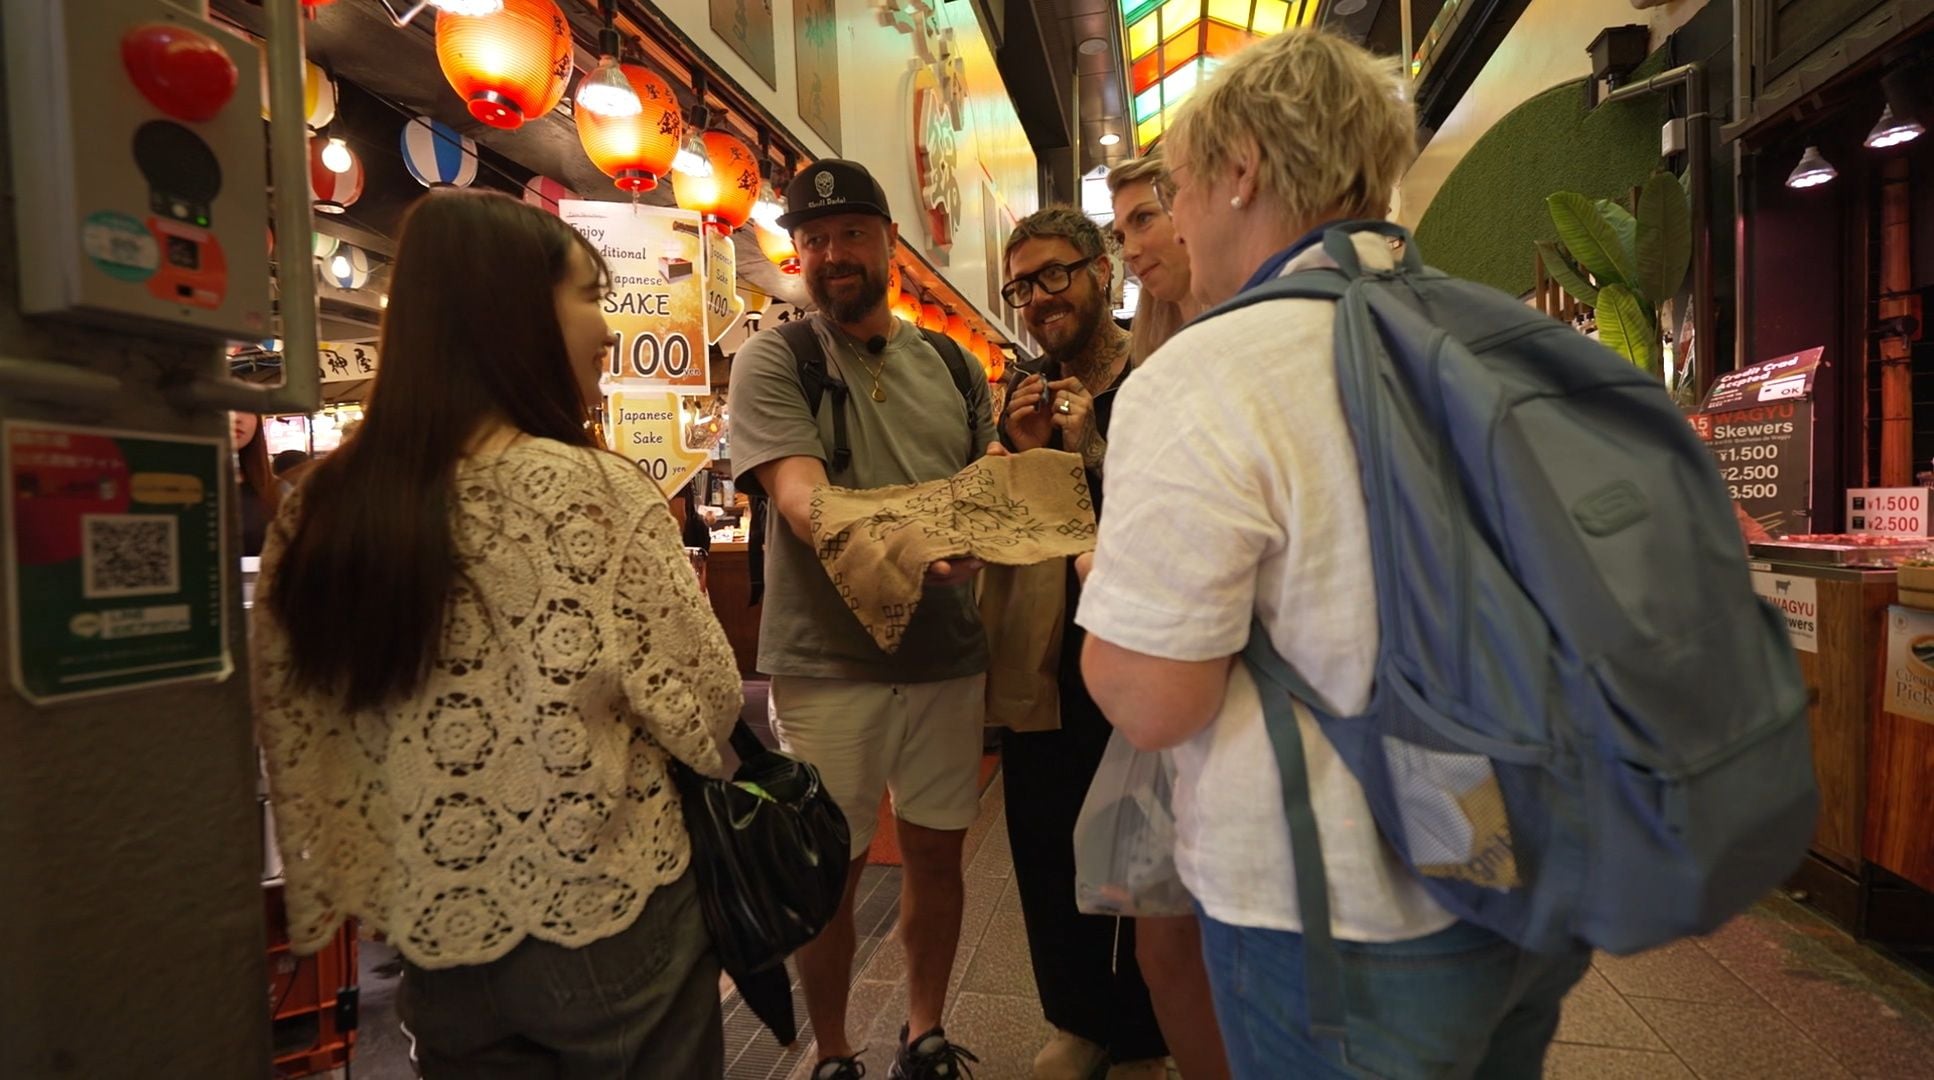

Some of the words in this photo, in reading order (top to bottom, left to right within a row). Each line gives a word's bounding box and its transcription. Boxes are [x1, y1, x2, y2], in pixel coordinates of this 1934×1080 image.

[600, 244, 646, 260] ditional
[610, 270, 662, 287] Japanese
[603, 291, 670, 316] SAKE
[708, 290, 728, 317] 100
[610, 332, 689, 376] 100
[1721, 367, 1760, 382] Credit
[1781, 387, 1799, 395] OK
[618, 408, 674, 425] Japanese
[633, 432, 663, 444] Sake
[1714, 422, 1794, 439] Skewers
[638, 458, 668, 480] 00
[673, 466, 687, 475] yen
[1787, 618, 1814, 632] wers
